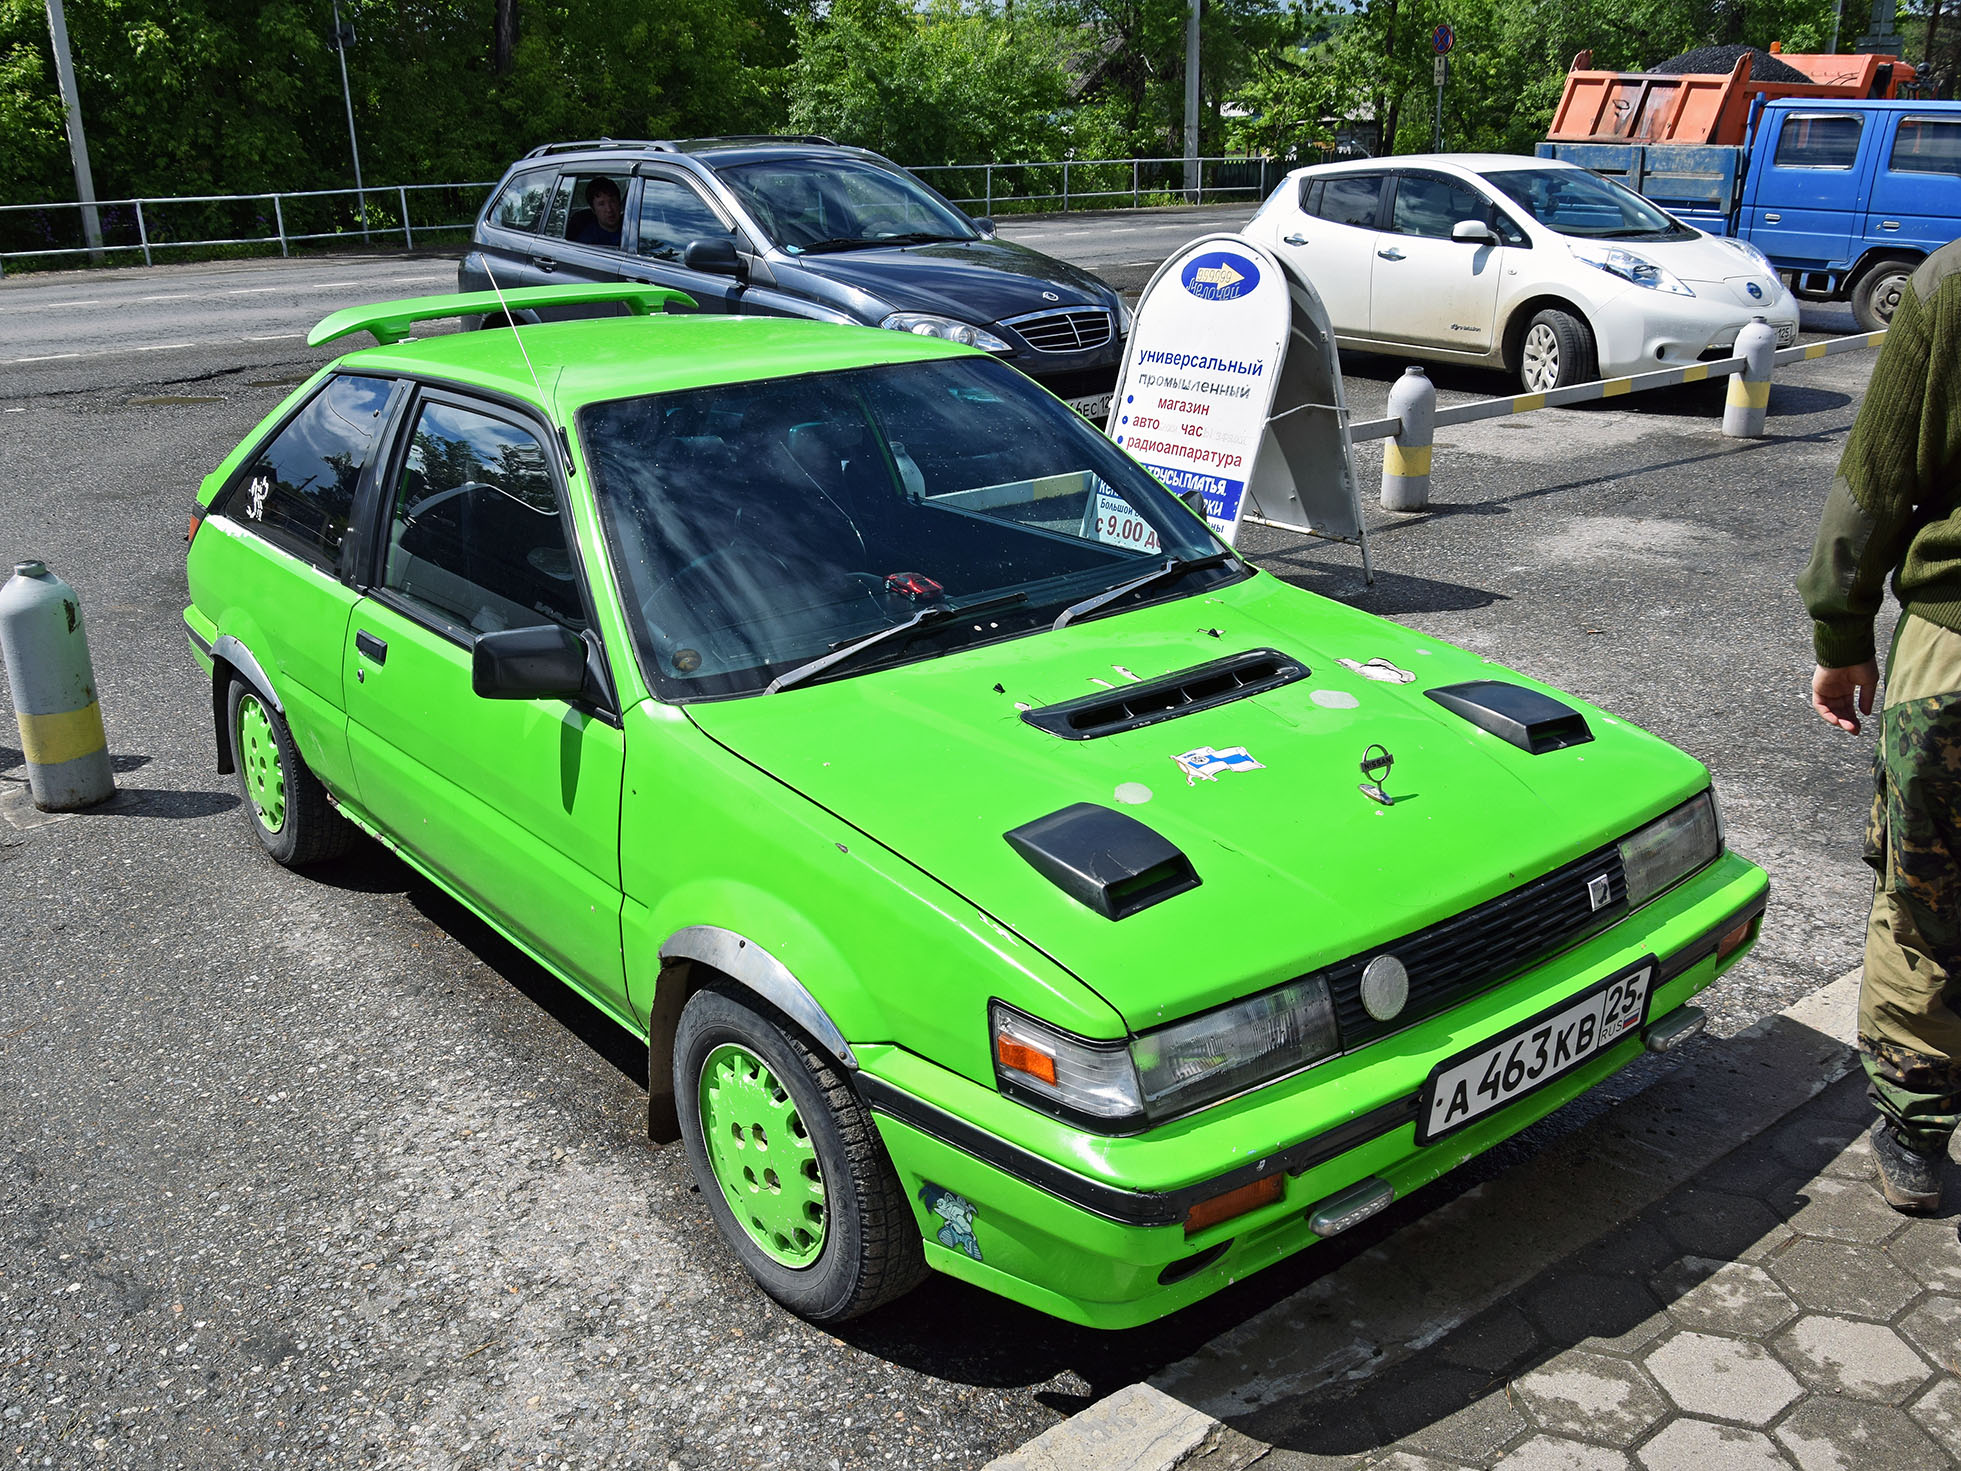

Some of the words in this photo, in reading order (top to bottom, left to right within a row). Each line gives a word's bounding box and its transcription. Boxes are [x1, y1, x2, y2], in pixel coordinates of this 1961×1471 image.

[1777, 327, 1790, 338] 125
[1138, 349, 1263, 377] универсальный
[1138, 373, 1251, 400] промышленный
[1100, 394, 1114, 414] 12
[1158, 398, 1210, 416] магазин
[1132, 415, 1160, 430] авто
[1126, 436, 1243, 468] радиоаппаратура
[1106, 515, 1144, 542] 9.00
[1364, 757, 1391, 770] NISSAN
[1605, 975, 1641, 1025] 25
[1601, 1021, 1623, 1041] RUS
[1444, 1013, 1596, 1124] А463КВ
